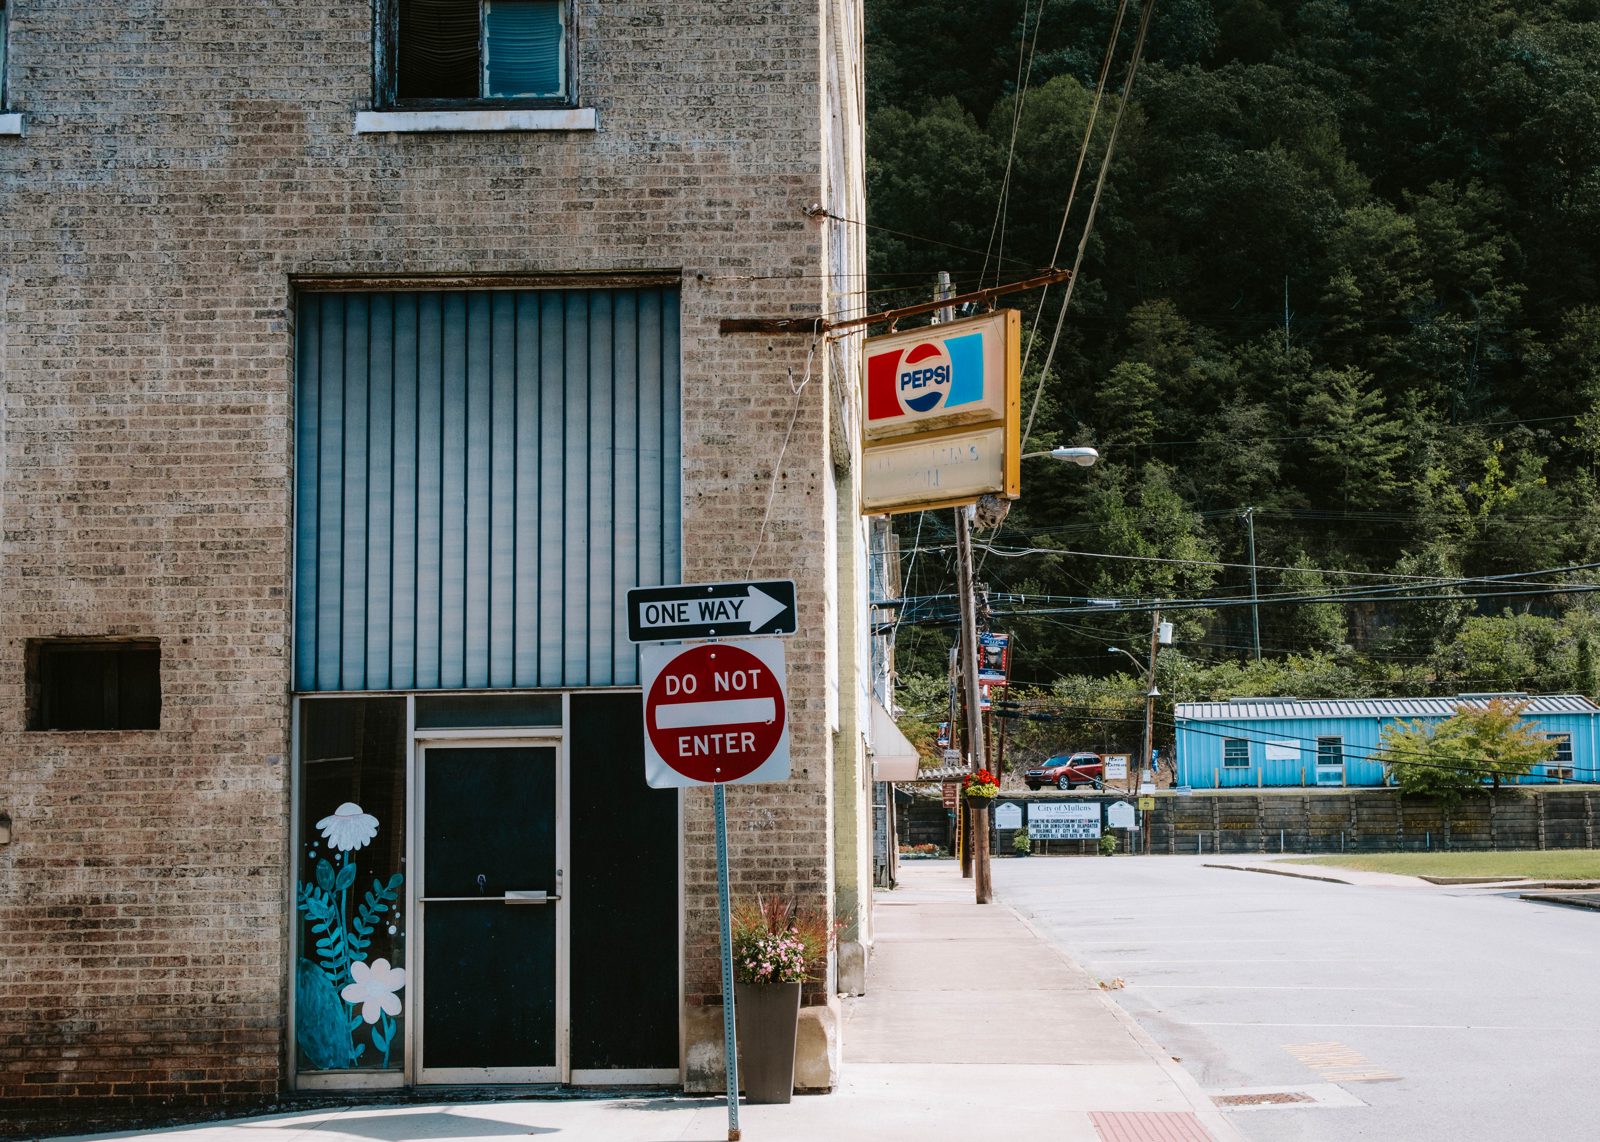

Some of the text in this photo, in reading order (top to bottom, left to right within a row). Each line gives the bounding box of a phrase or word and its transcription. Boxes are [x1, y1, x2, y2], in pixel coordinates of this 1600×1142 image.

[900, 365, 950, 391] PEPSI
[645, 599, 744, 625] ONE WAY
[665, 669, 761, 696] DO NOT
[678, 731, 756, 757] ENTER
